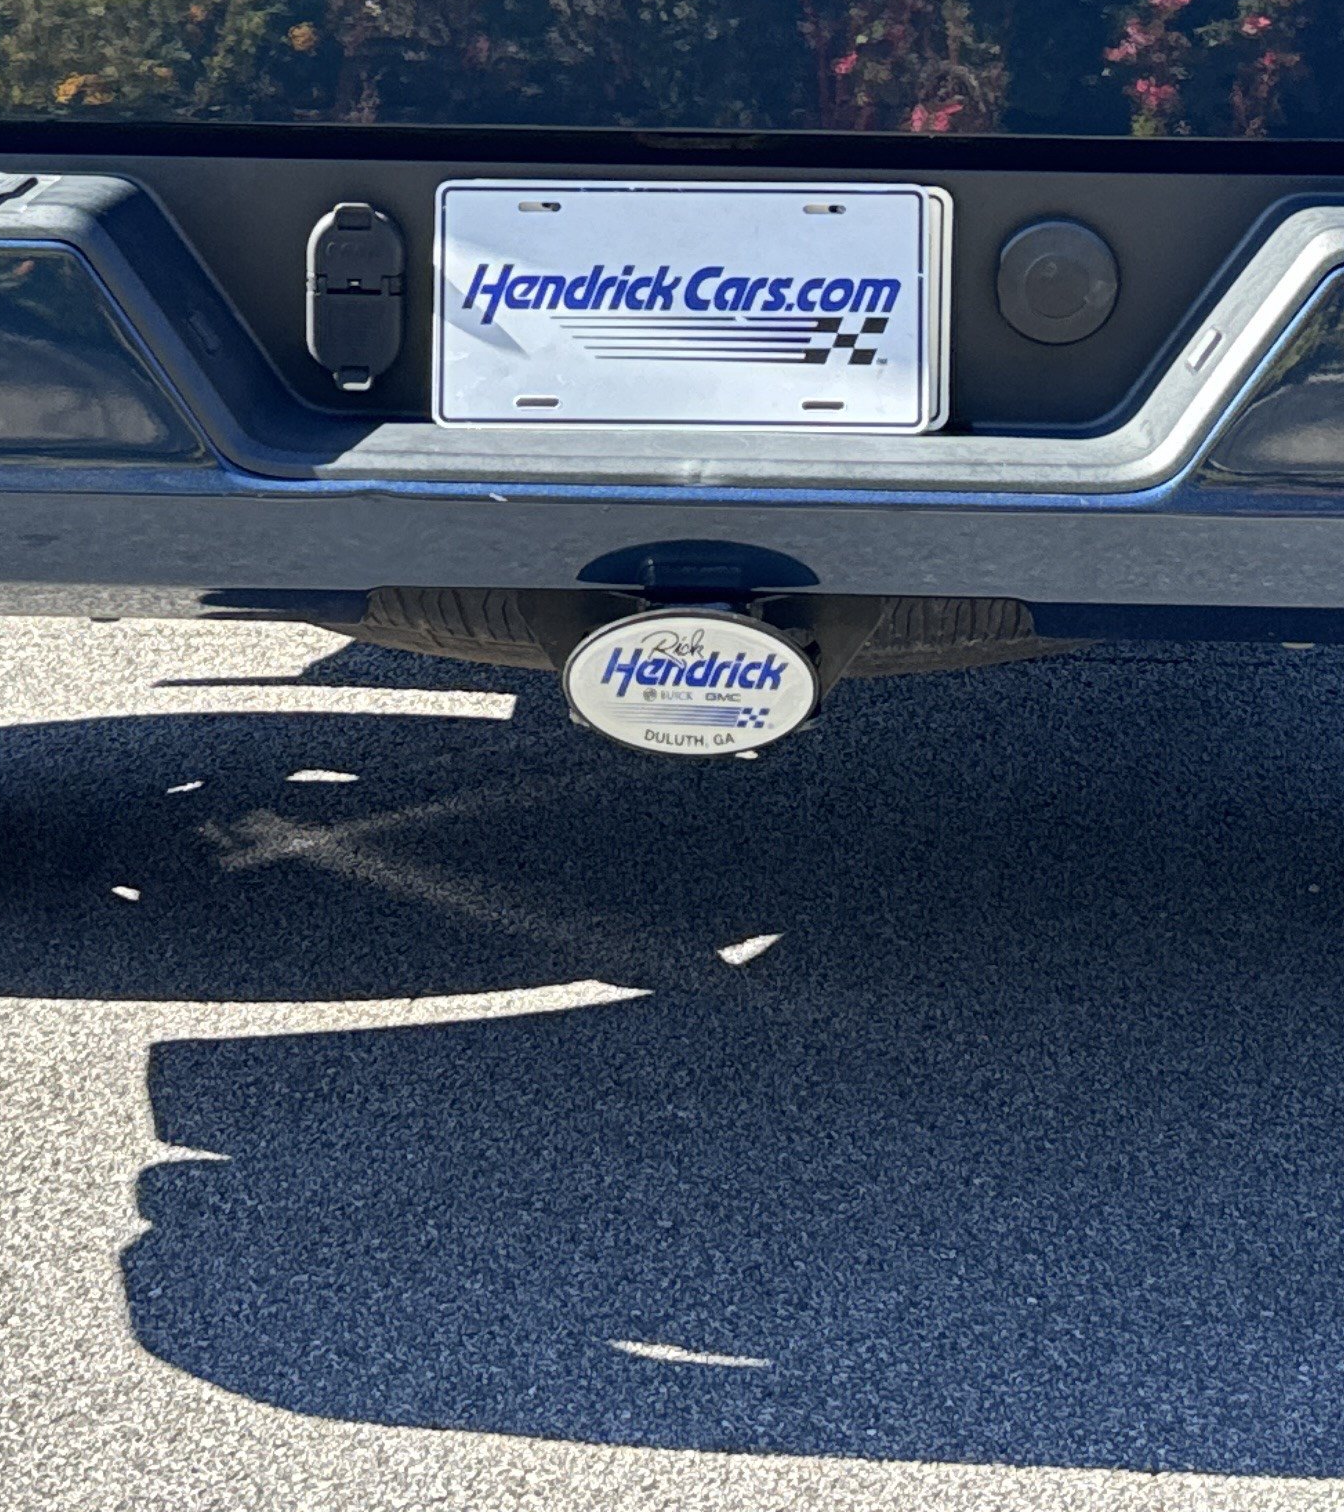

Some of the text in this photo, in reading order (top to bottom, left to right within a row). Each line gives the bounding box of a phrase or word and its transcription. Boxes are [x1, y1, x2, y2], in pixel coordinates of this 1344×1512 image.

[640, 628, 706, 662] Rick
[599, 646, 790, 698] Hendrick
[704, 691, 742, 703] GMC
[712, 732, 736, 747] GA
